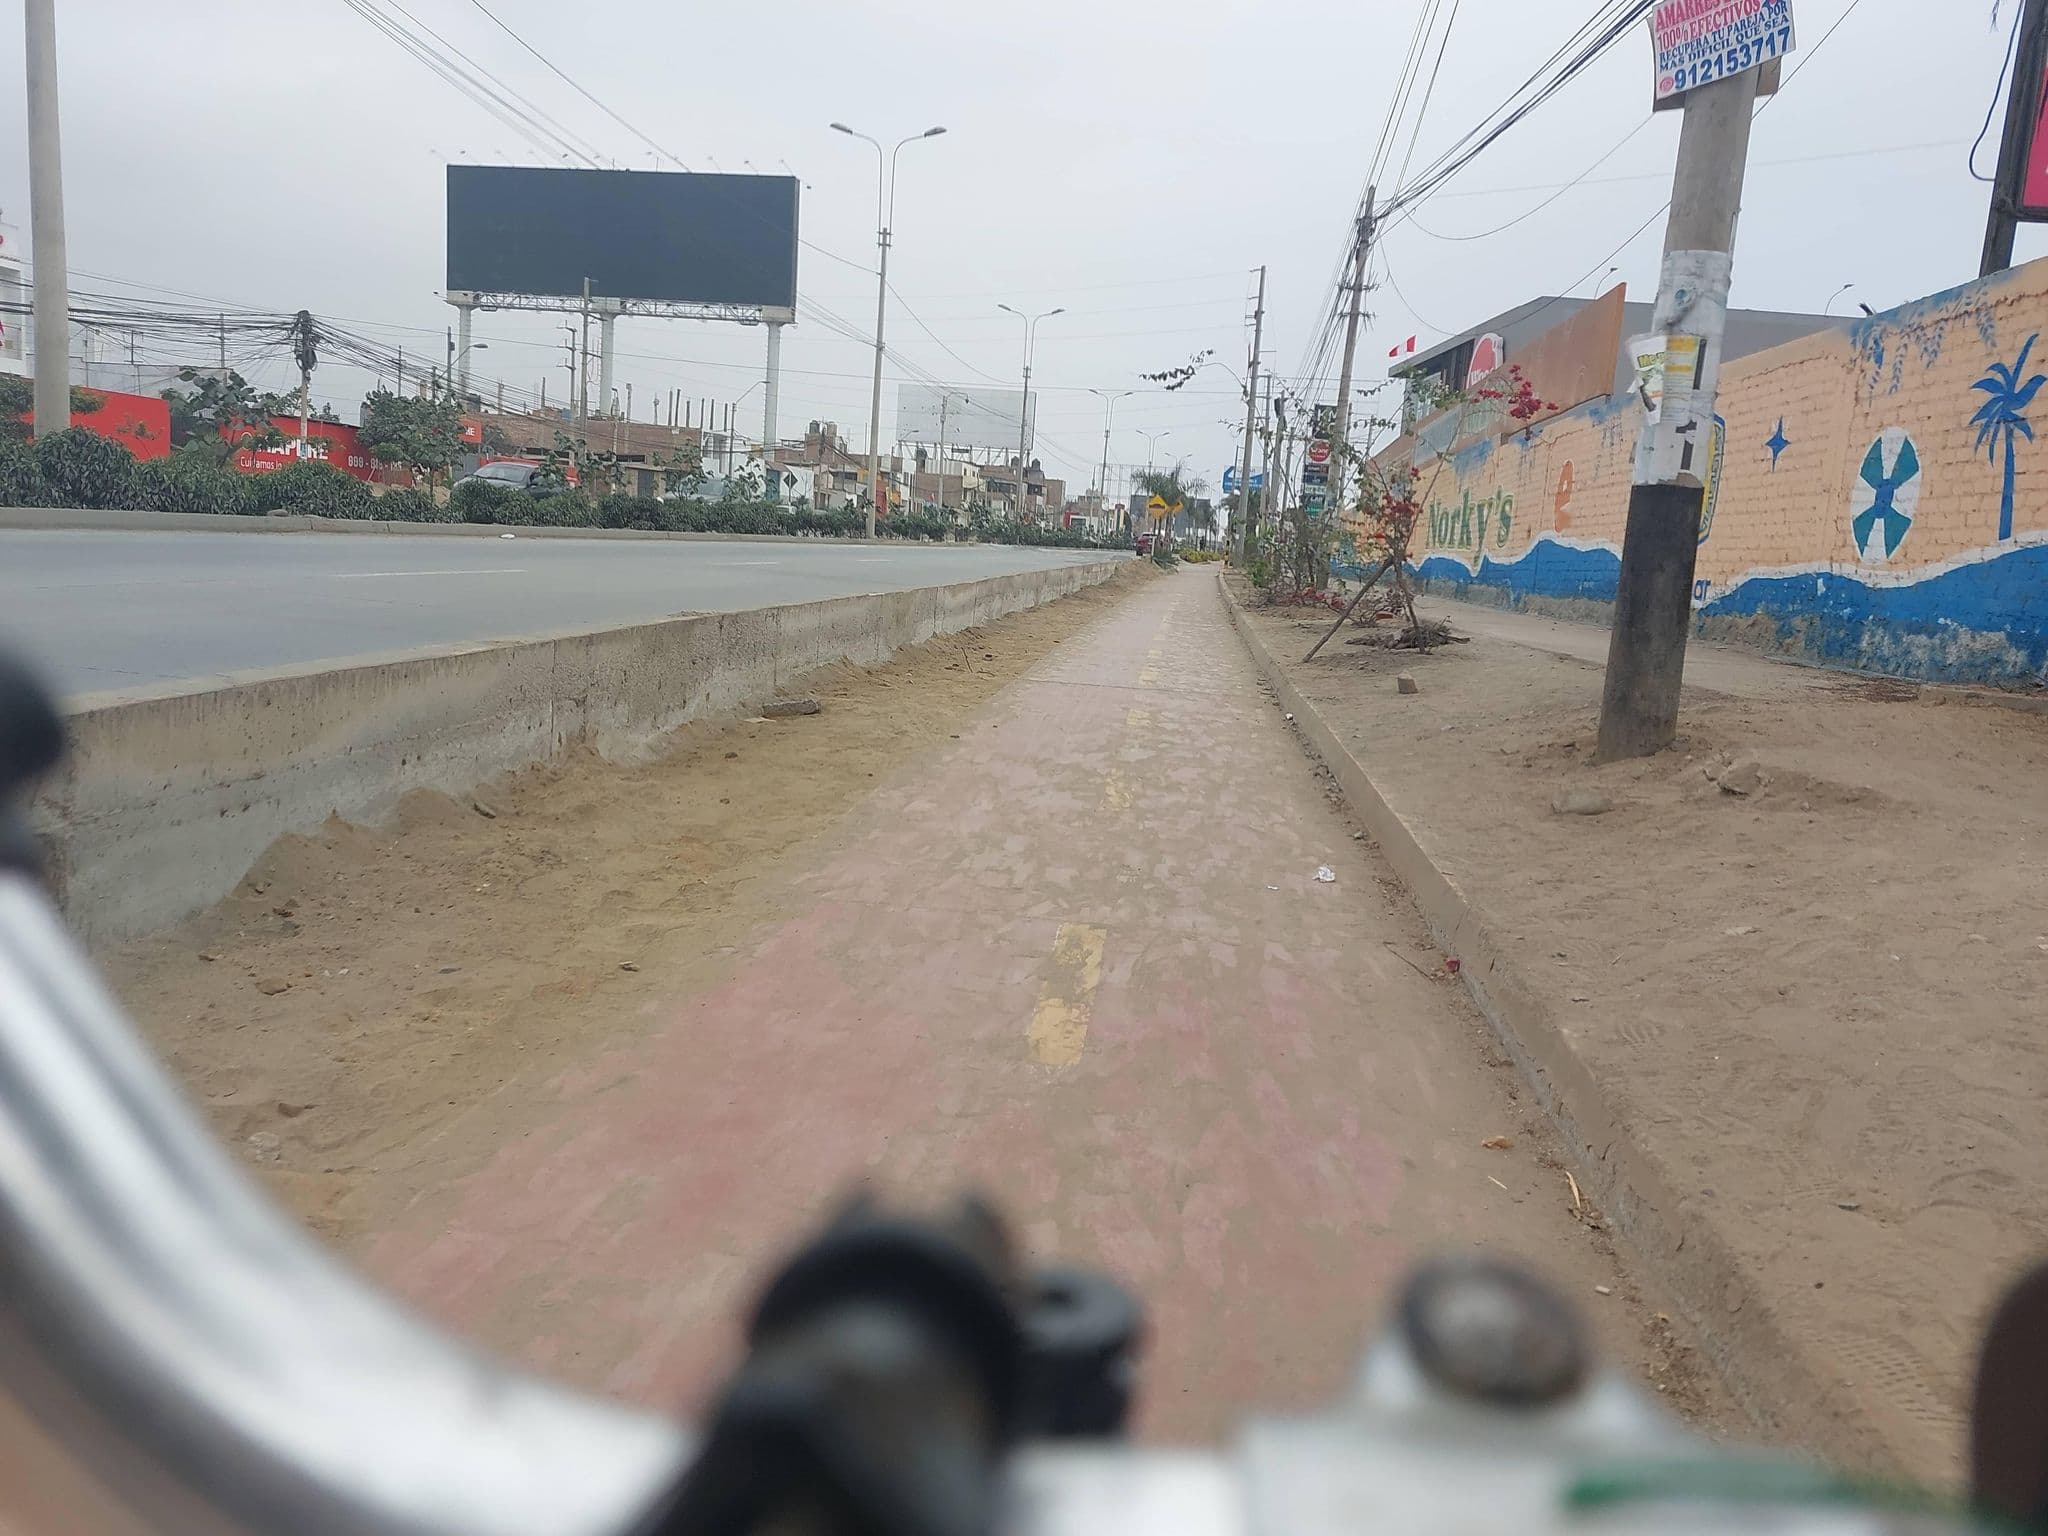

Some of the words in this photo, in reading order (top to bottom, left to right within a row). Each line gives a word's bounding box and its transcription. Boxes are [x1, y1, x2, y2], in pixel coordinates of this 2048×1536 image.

[1657, 23, 1689, 51] 100%
[1689, 0, 1761, 39] EFECTIVOS
[1659, 34, 1709, 62] RECUPERA
[1711, 27, 1725, 42] TU
[1727, 11, 1765, 37] PAREJA
[1767, 0, 1787, 19] POR
[1659, 56, 1685, 73] MAS
[1687, 38, 1733, 62] DIFICIL
[1735, 25, 1761, 45] QUE
[1764, 14, 1789, 31] SEA
[1674, 25, 1790, 89] 912153717
[1425, 484, 1515, 568] Norky's
